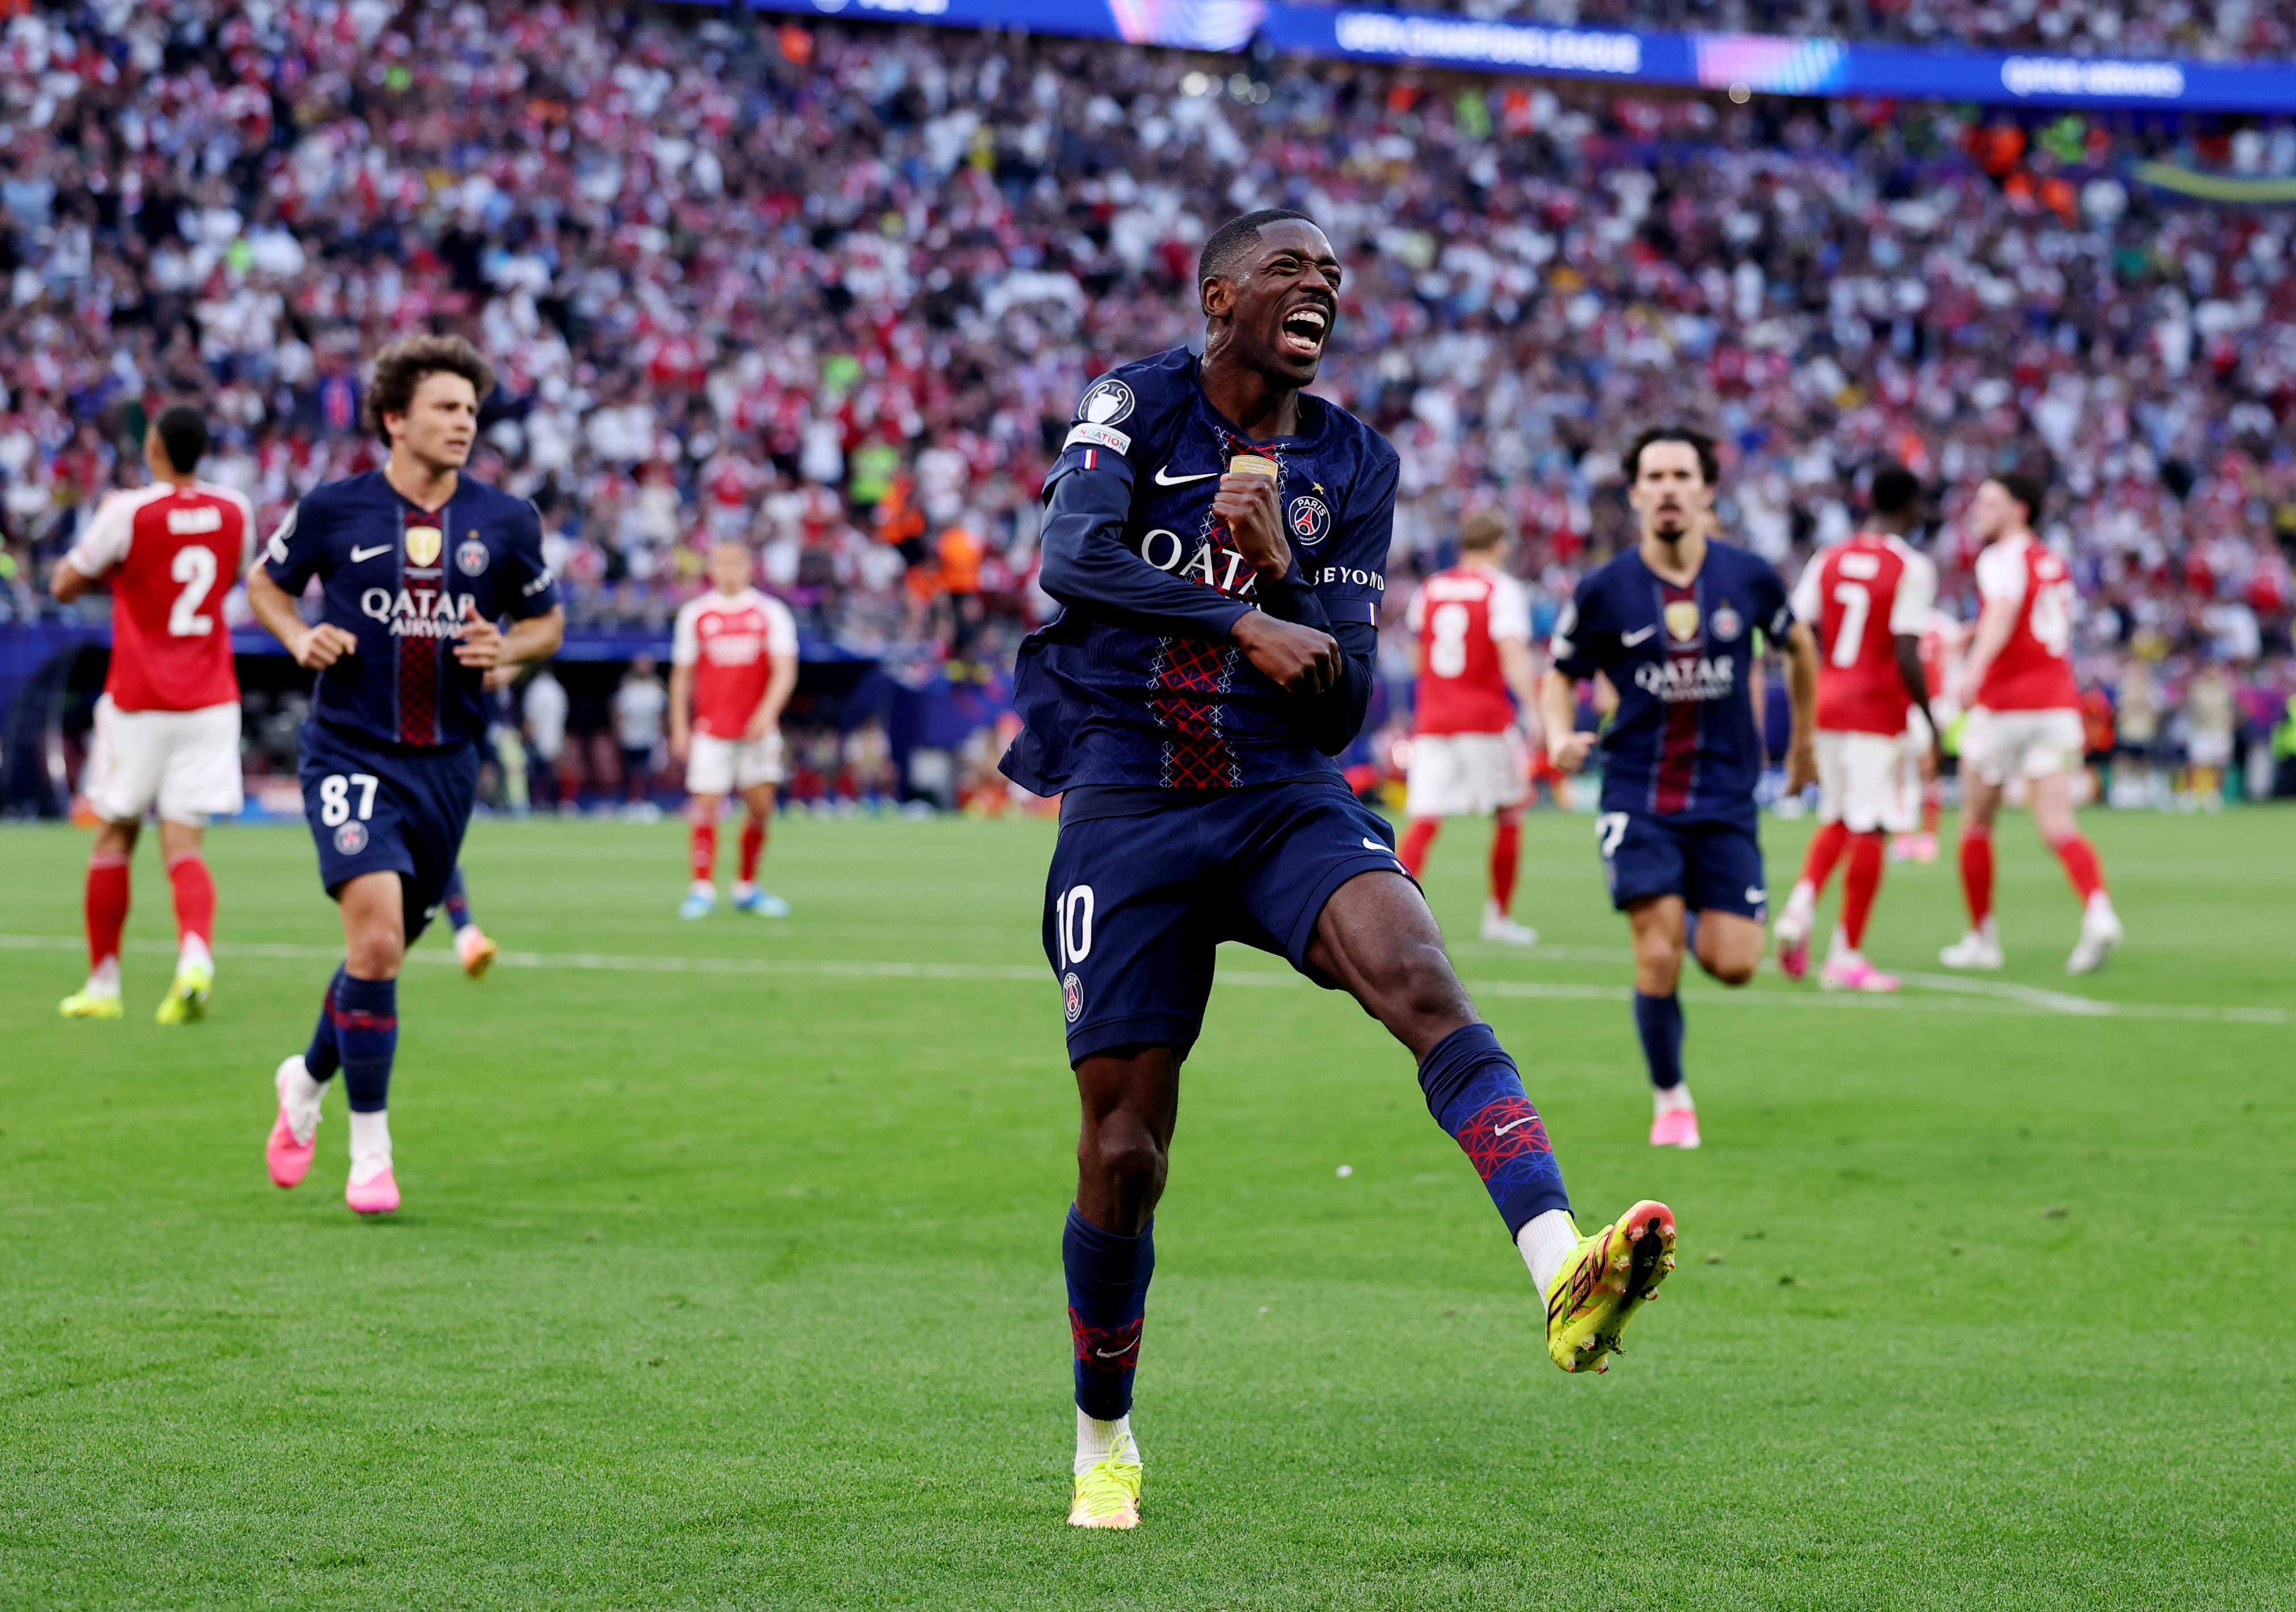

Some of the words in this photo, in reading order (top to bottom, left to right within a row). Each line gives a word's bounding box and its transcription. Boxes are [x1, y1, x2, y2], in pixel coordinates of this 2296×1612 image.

[1068, 429, 1127, 451] NDATION
[1297, 498, 1326, 516] PARIS
[1141, 529, 1258, 595] QAT
[168, 543, 217, 637] 2
[360, 587, 476, 624] QATAR
[388, 617, 468, 641] AIRWA
[1430, 603, 1470, 679] 8
[1831, 581, 1870, 668] 7
[320, 773, 379, 828] 87
[1057, 884, 1094, 970] 10
[1064, 975, 1078, 990] PARIS
